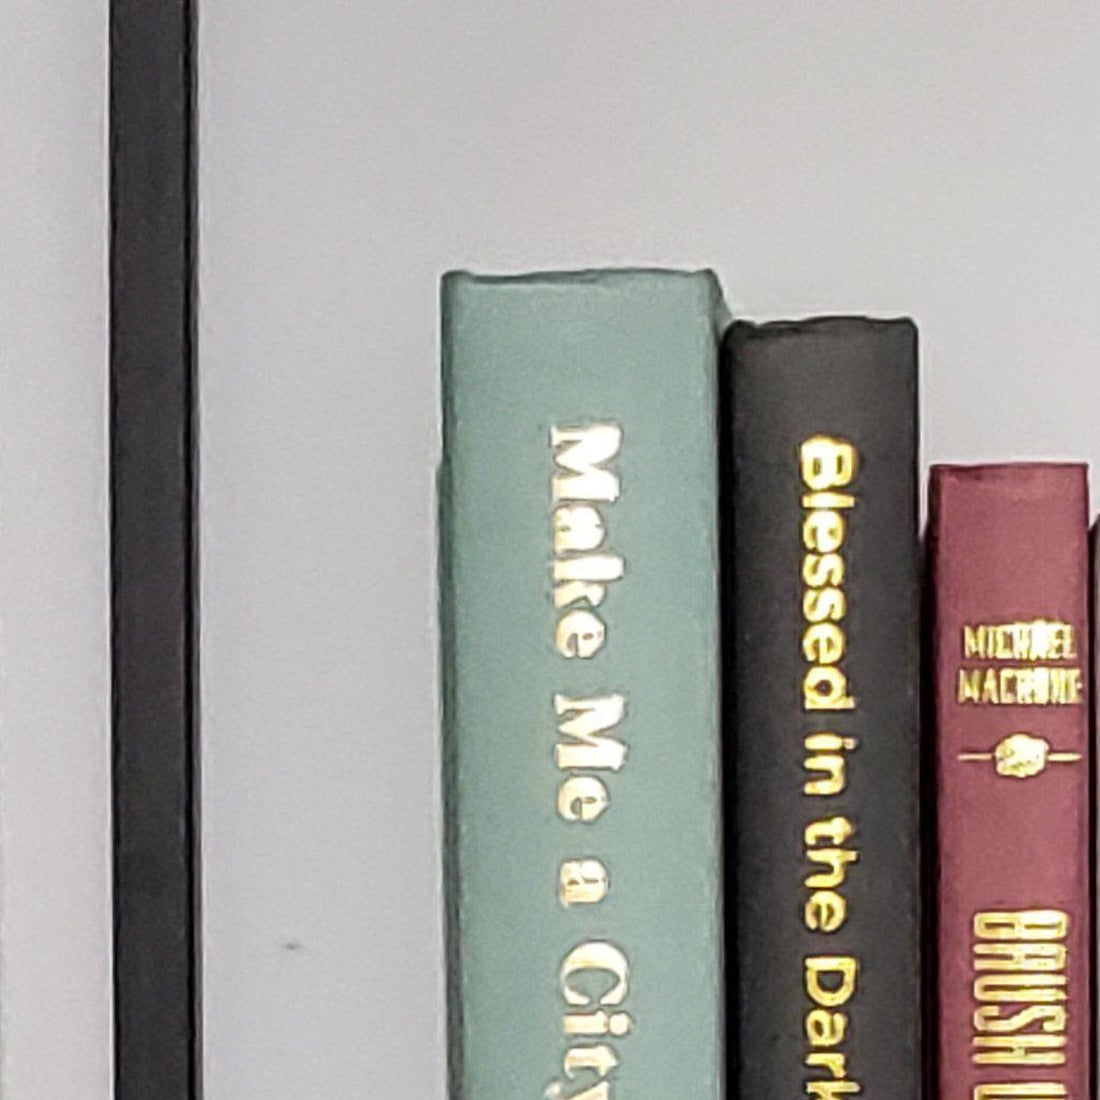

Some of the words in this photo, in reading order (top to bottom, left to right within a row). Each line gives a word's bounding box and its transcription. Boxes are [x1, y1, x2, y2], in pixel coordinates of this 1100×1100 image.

[551, 424, 624, 659] Make
[800, 437, 856, 711] Blessed
[555, 694, 628, 822] Me
[805, 734, 857, 796] in
[560, 860, 609, 908] a
[805, 817, 858, 932] the
[973, 911, 1069, 1065] BRUSH
